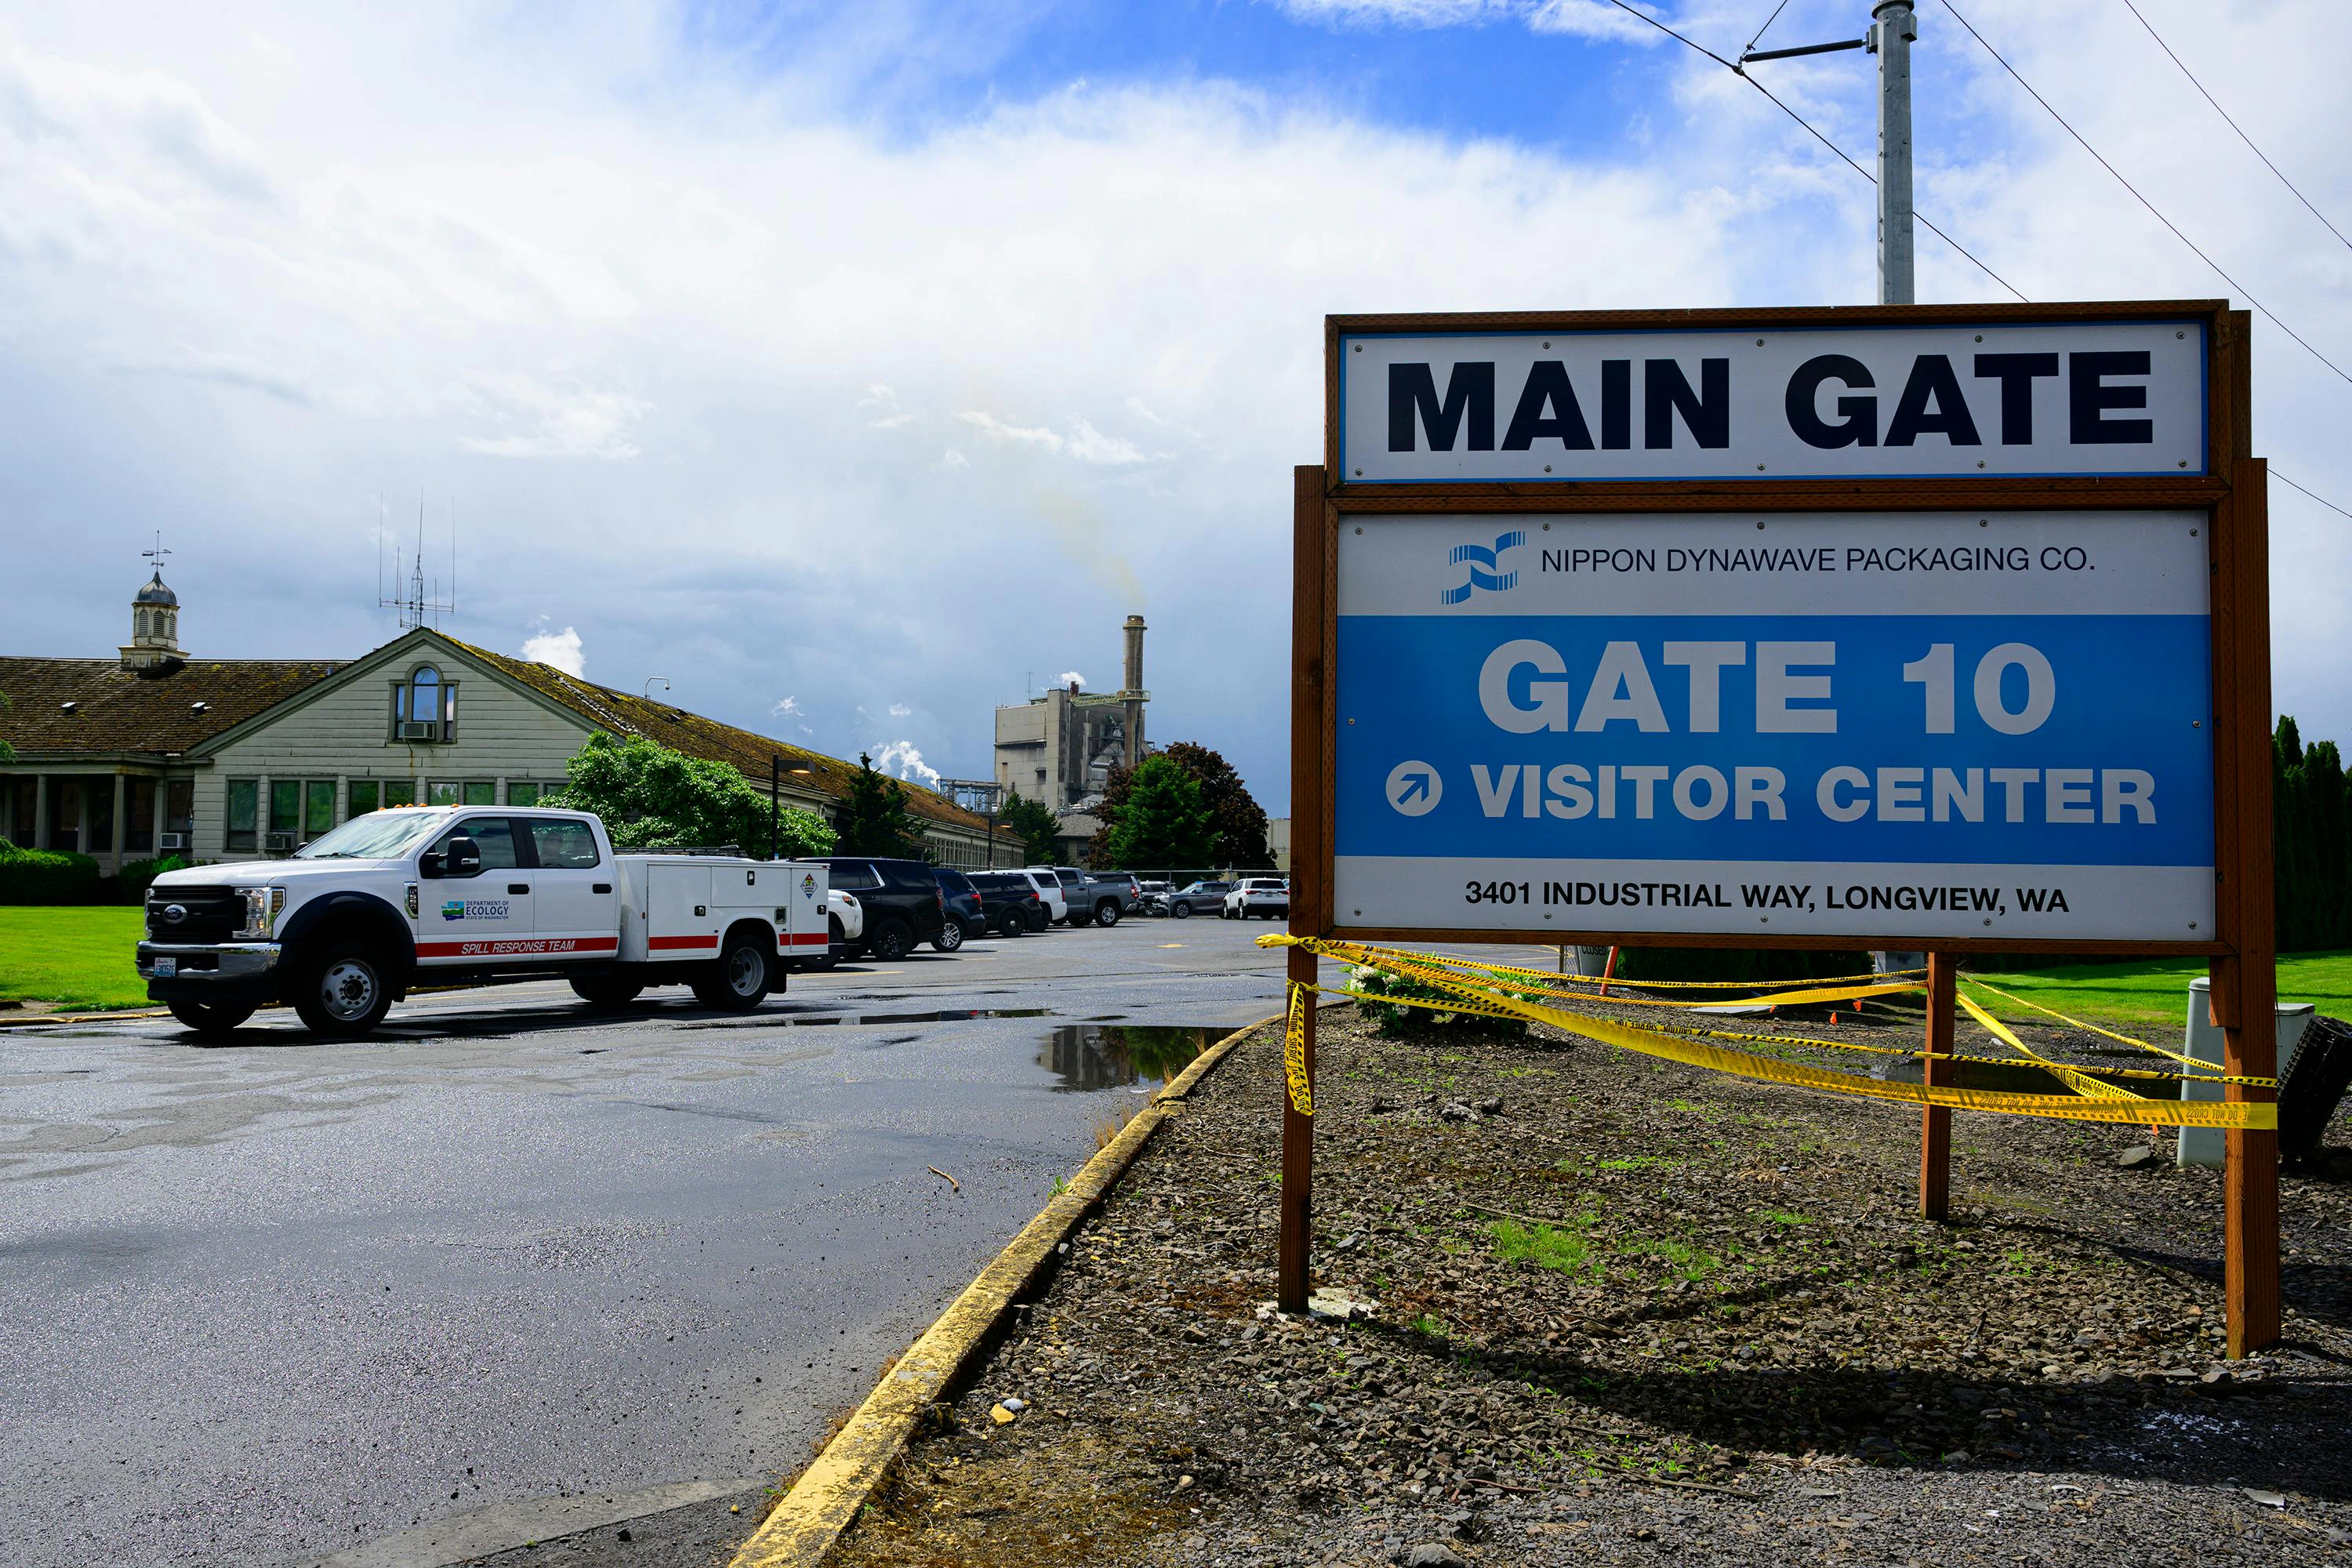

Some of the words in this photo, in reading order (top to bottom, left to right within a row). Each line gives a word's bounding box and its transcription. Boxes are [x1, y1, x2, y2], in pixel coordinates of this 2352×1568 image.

[1388, 358, 1730, 452] MAIN
[1785, 350, 2153, 450] GATE
[1542, 549, 1655, 572] NIPPON
[1667, 548, 1835, 572] DYNAWAVE
[1846, 546, 2029, 572] PACKAGING
[2040, 546, 2095, 571] CO.
[1479, 639, 1837, 734] GATE
[1903, 643, 2056, 735] 10
[1470, 764, 1786, 821] VISITOR
[1817, 766, 2157, 824] CENTER
[466, 906, 509, 916] ECOLOGY
[1465, 880, 1530, 905] 3401
[1544, 881, 1732, 908] INDUSTRIAL
[1740, 884, 1815, 913] WAY,
[1827, 885, 2005, 916] LONGVIEW,
[2016, 888, 2070, 913] WA
[461, 943, 489, 955] SPILL
[492, 941, 546, 953] RESPONSE
[548, 940, 576, 951] TEAM
